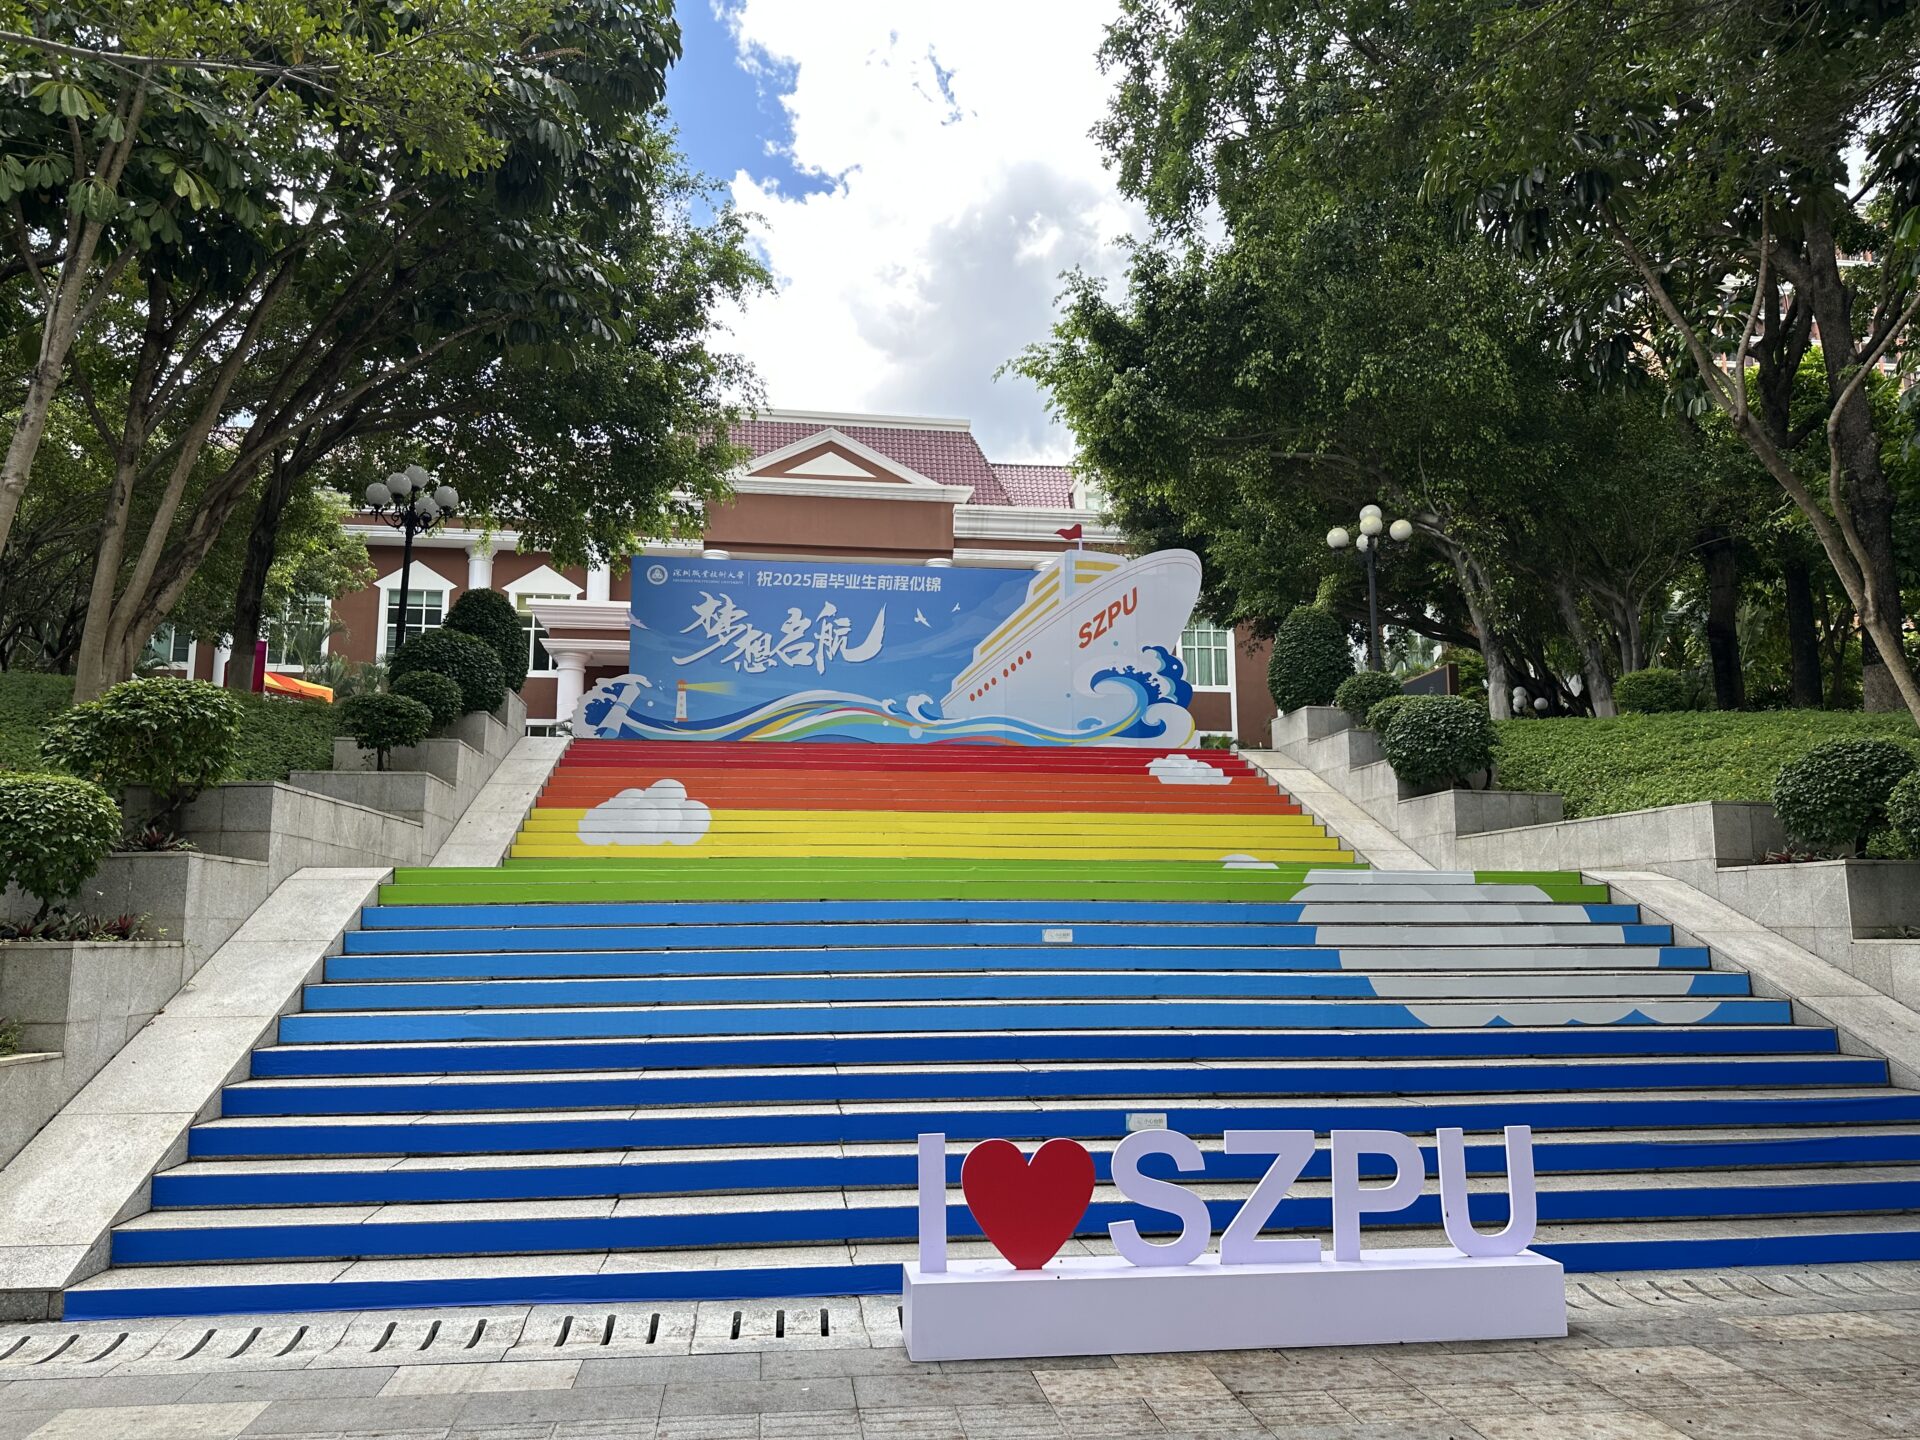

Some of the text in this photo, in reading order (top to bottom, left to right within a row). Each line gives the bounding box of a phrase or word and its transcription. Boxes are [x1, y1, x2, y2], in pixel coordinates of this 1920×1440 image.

[756, 570, 942, 593] 祝2025届毕业生前程似锦
[1078, 586, 1138, 649] SZPU
[672, 591, 887, 675] 梦想启航
[917, 1125, 1538, 1273] I SZPU
